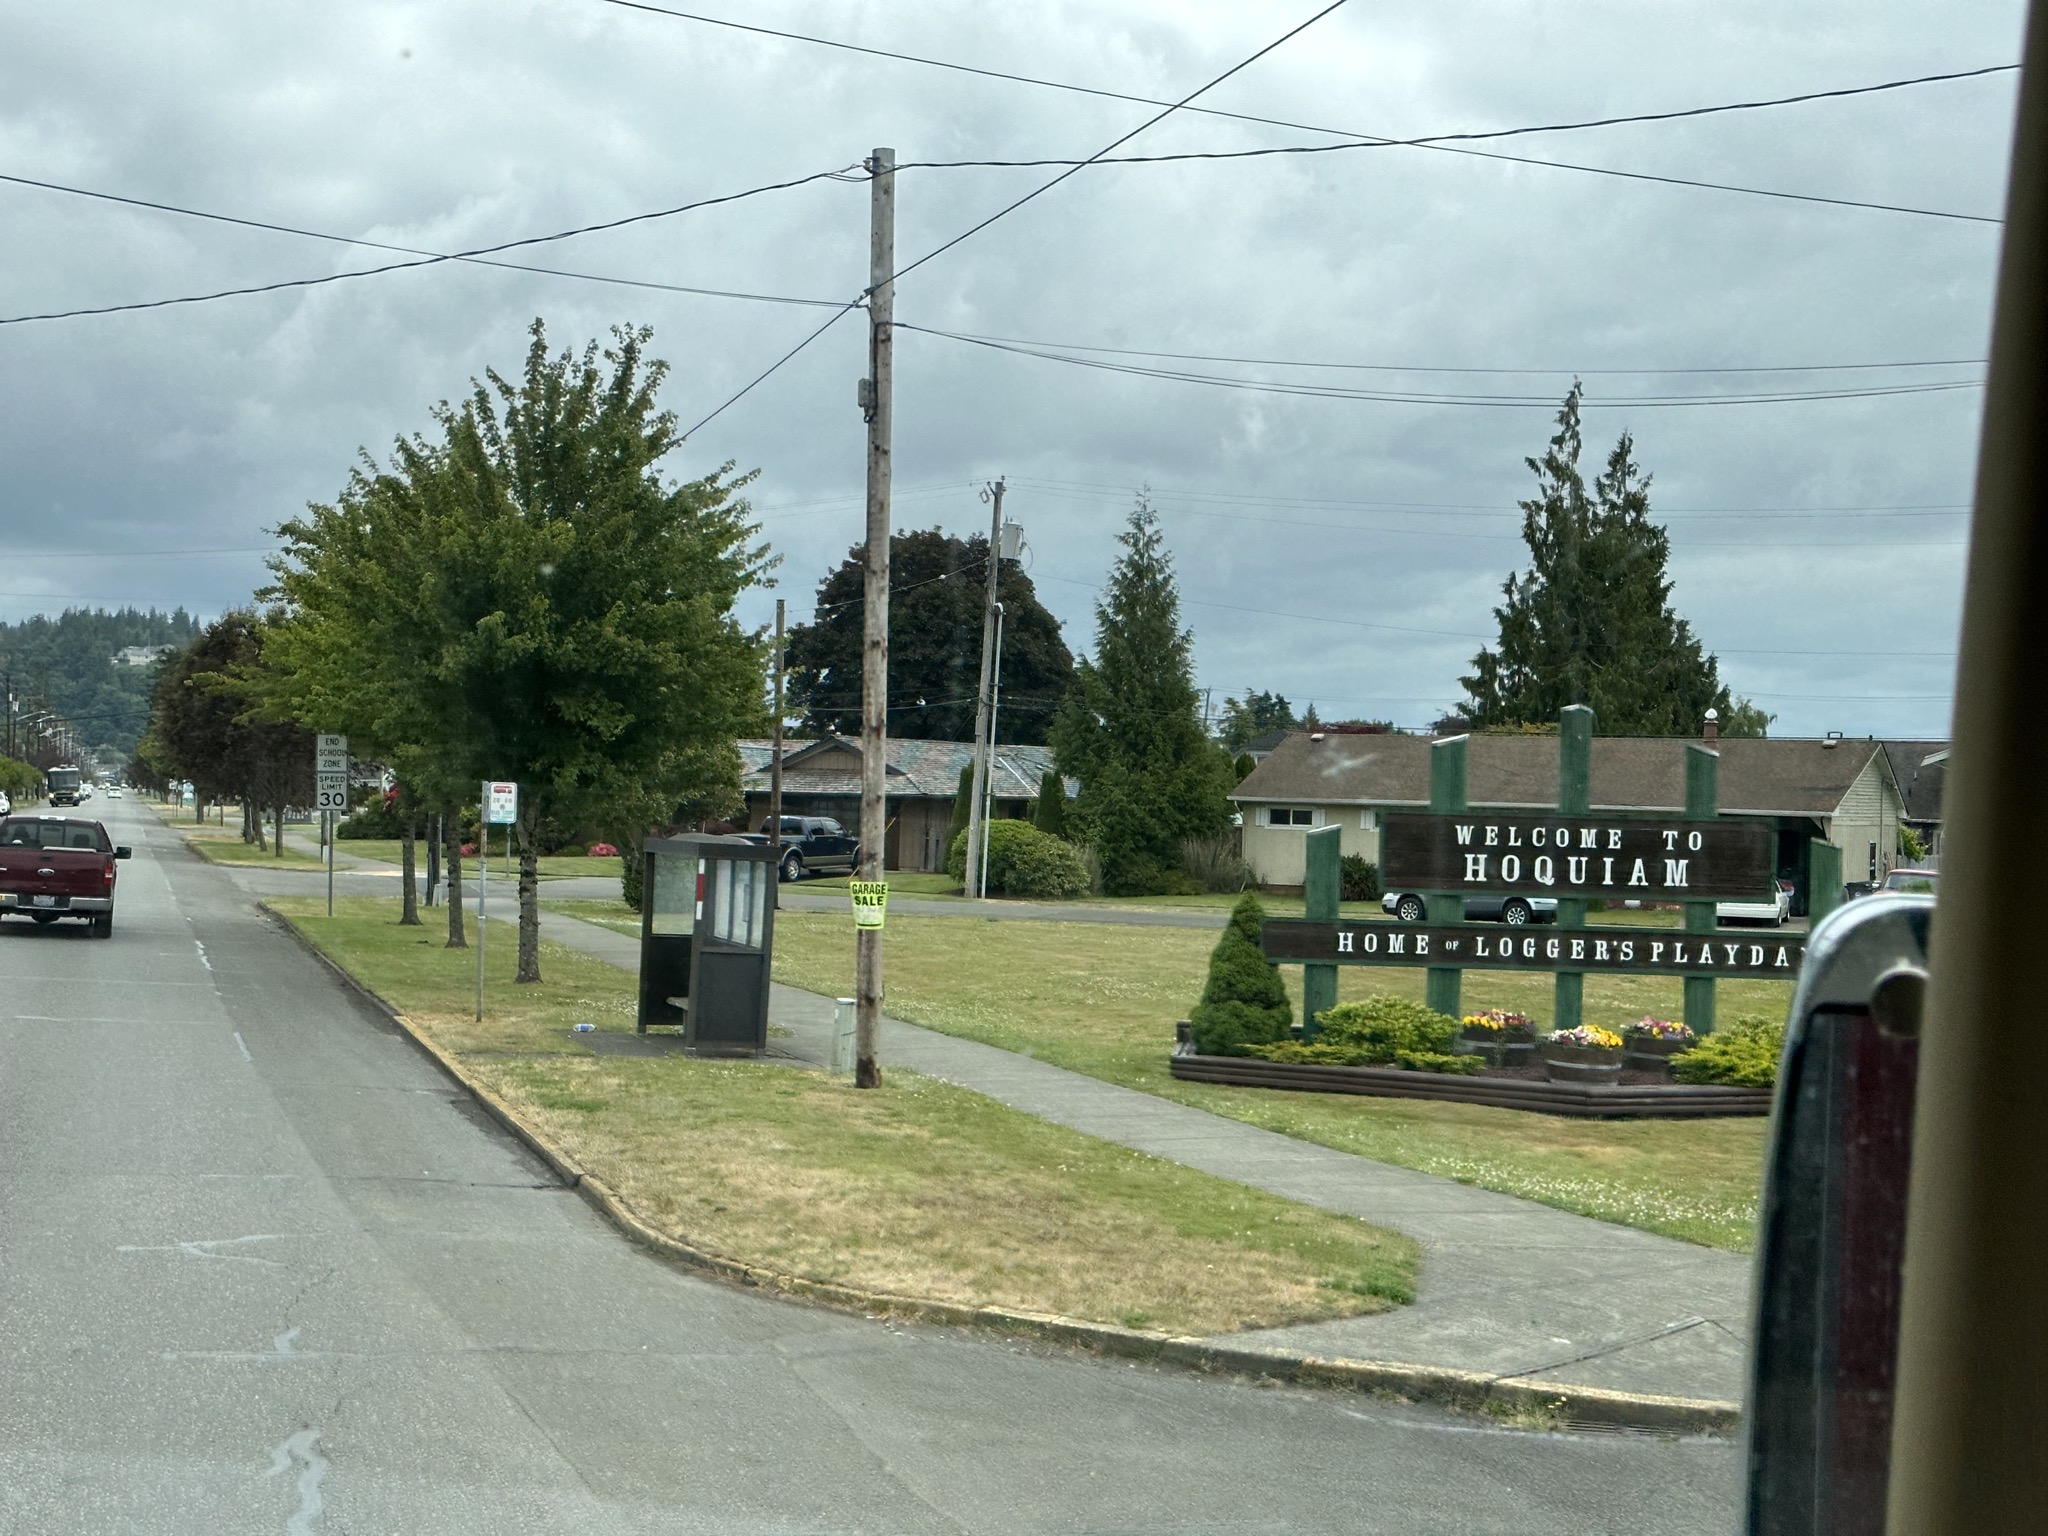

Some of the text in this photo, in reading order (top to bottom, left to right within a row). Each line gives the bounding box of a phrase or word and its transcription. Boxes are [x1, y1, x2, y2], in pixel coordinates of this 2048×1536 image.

[325, 738, 339, 746] END
[318, 749, 345, 757] SCHOOL
[323, 760, 341, 768] ZONE
[319, 792, 344, 807] 30
[1455, 824, 1702, 851] WELCOME TO
[1463, 853, 1689, 887] HOQUIAM
[852, 883, 886, 895] GARAGE
[854, 895, 884, 906] SALE
[1337, 932, 1806, 967] HOME OF LOGGER'S PLAYDA
